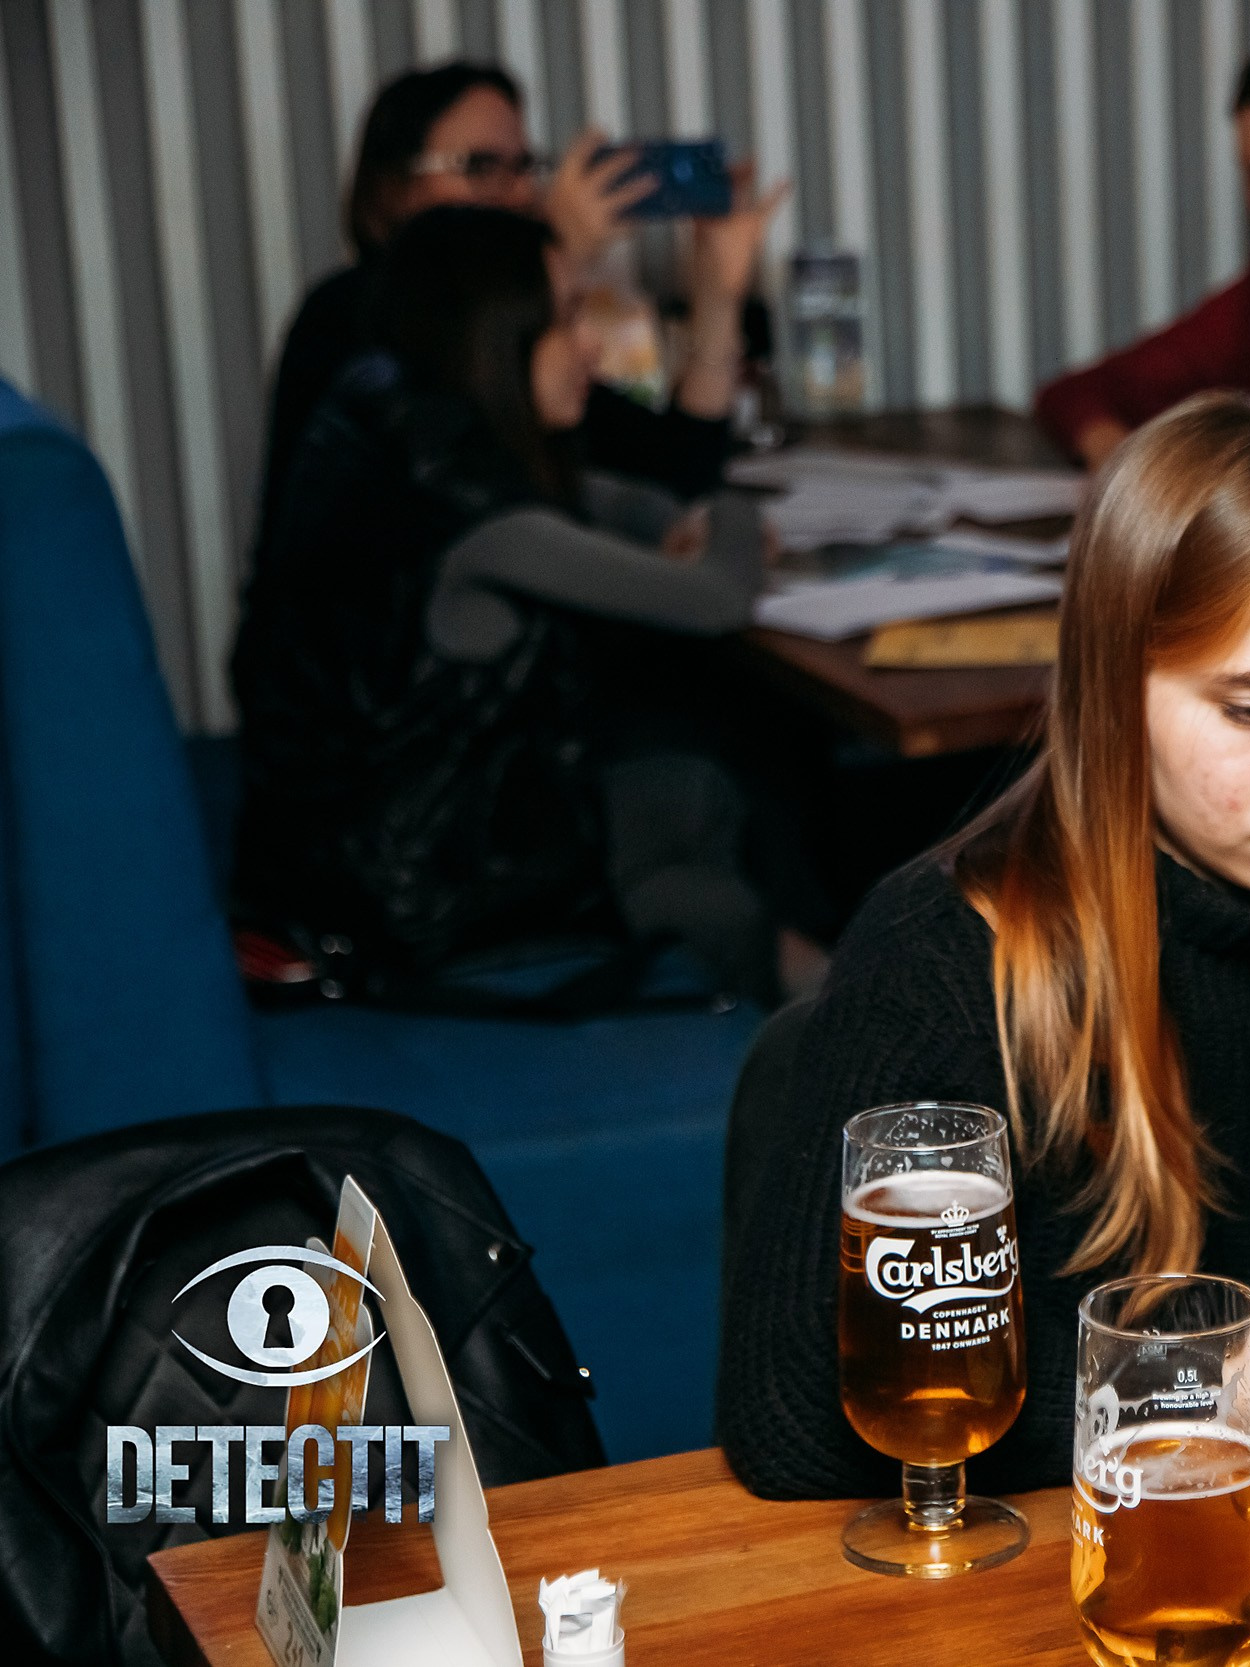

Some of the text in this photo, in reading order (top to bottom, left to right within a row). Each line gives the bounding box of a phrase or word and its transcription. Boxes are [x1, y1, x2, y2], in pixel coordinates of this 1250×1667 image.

[865, 1236, 1019, 1301] Carlsberg
[932, 1304, 987, 1319] COPENHAGEN
[900, 1307, 1011, 1340] DENMARK
[931, 1335, 991, 1351] 1847 ONWARDS
[1152, 1394, 1180, 1402] Brewing
[1196, 1391, 1209, 1400] high
[1160, 1399, 1215, 1409] honourable level
